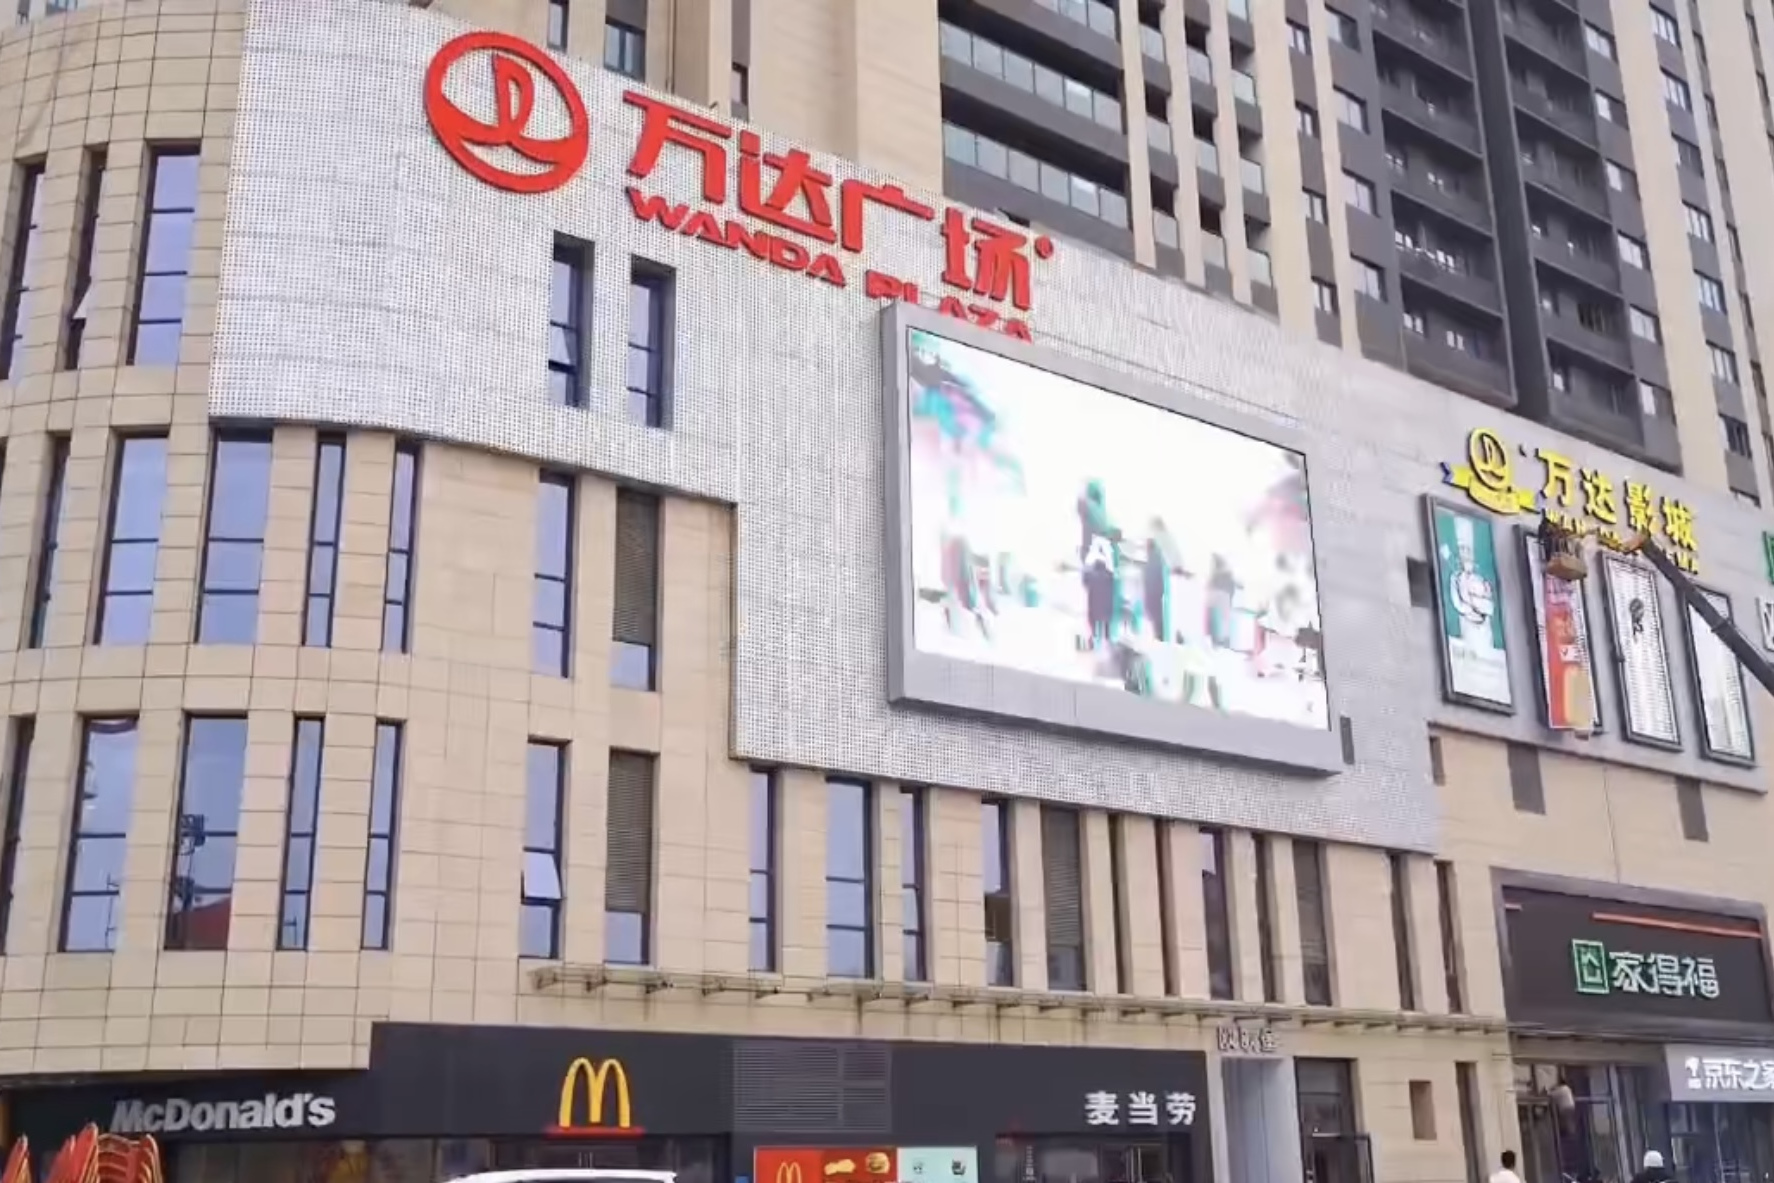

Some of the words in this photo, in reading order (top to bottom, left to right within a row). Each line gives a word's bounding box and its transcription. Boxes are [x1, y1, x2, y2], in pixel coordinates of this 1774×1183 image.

[623, 90, 1034, 310] 万达广场
[626, 186, 846, 286] WANDA
[1535, 446, 1697, 551] 万达影城
[1608, 950, 1720, 998] 家得福
[111, 1092, 336, 1134] McDonald's
[1084, 1091, 1197, 1127] 麦当劳
